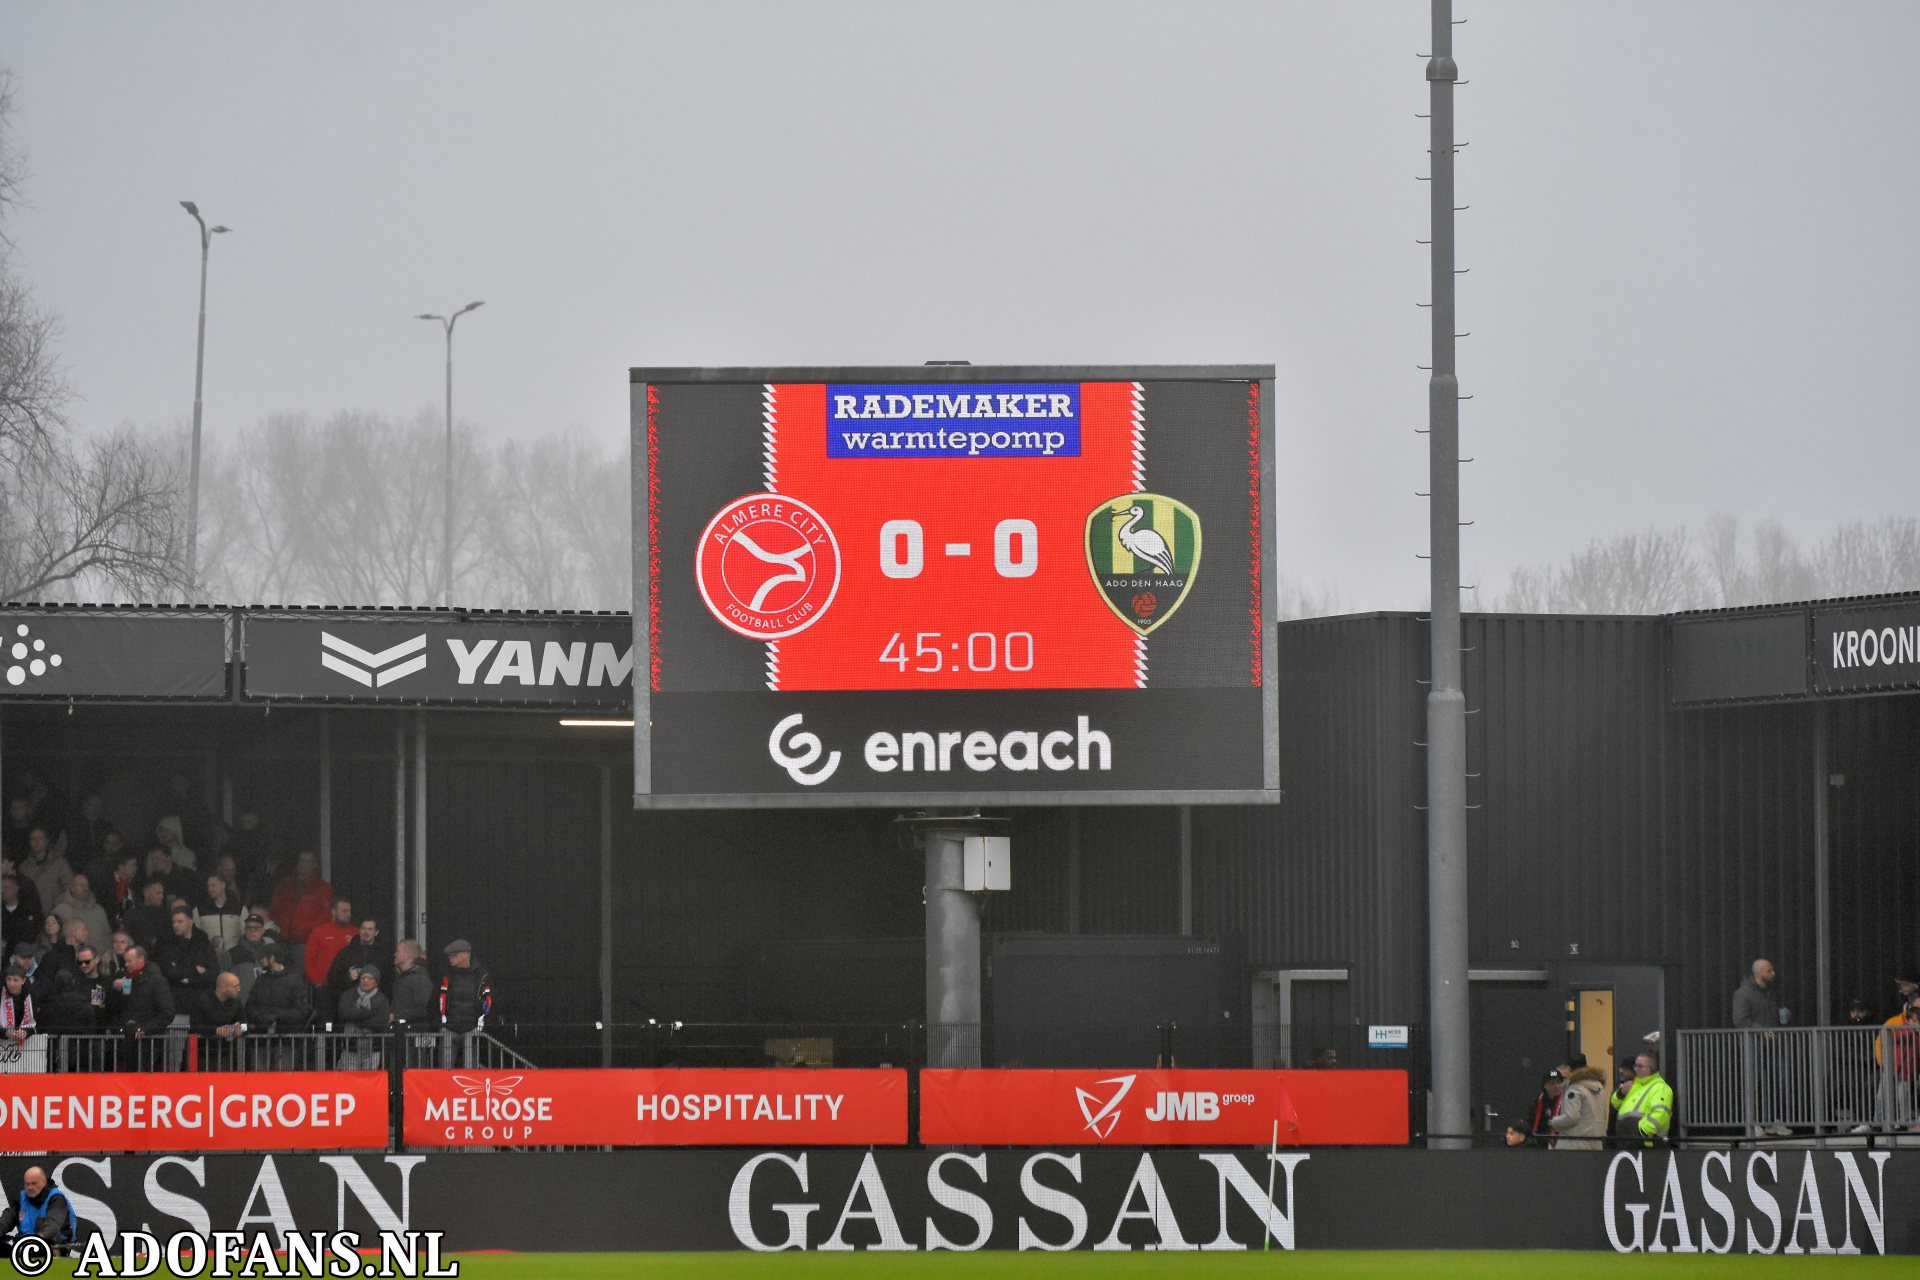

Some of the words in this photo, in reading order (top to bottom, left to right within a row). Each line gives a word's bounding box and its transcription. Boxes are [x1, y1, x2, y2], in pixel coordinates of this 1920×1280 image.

[834, 394, 1074, 419] RADEMAKER
[842, 427, 1065, 455] warmtepomp
[714, 503, 783, 545] ALMERE
[790, 511, 826, 545] CITY
[879, 519, 924, 578] 0
[994, 519, 1039, 578] 0
[1105, 580, 1128, 588] ADO
[1131, 580, 1151, 588] DEN
[1155, 580, 1184, 588] HAAG
[725, 603, 783, 628] FOOTBALL
[786, 602, 813, 624] CLUB
[878, 631, 1034, 673] 45:00
[1833, 625, 1920, 669] KROON
[864, 715, 1112, 773] enreach
[424, 1097, 552, 1122] MELROSE
[637, 1094, 844, 1121] HOSPITALITY
[1145, 1091, 1220, 1122] JMB
[1222, 1094, 1255, 1106] groep
[445, 1127, 533, 1140] GROUP
[728, 1152, 1310, 1252] GASSAN
[1603, 1151, 1890, 1255] GASSAN
